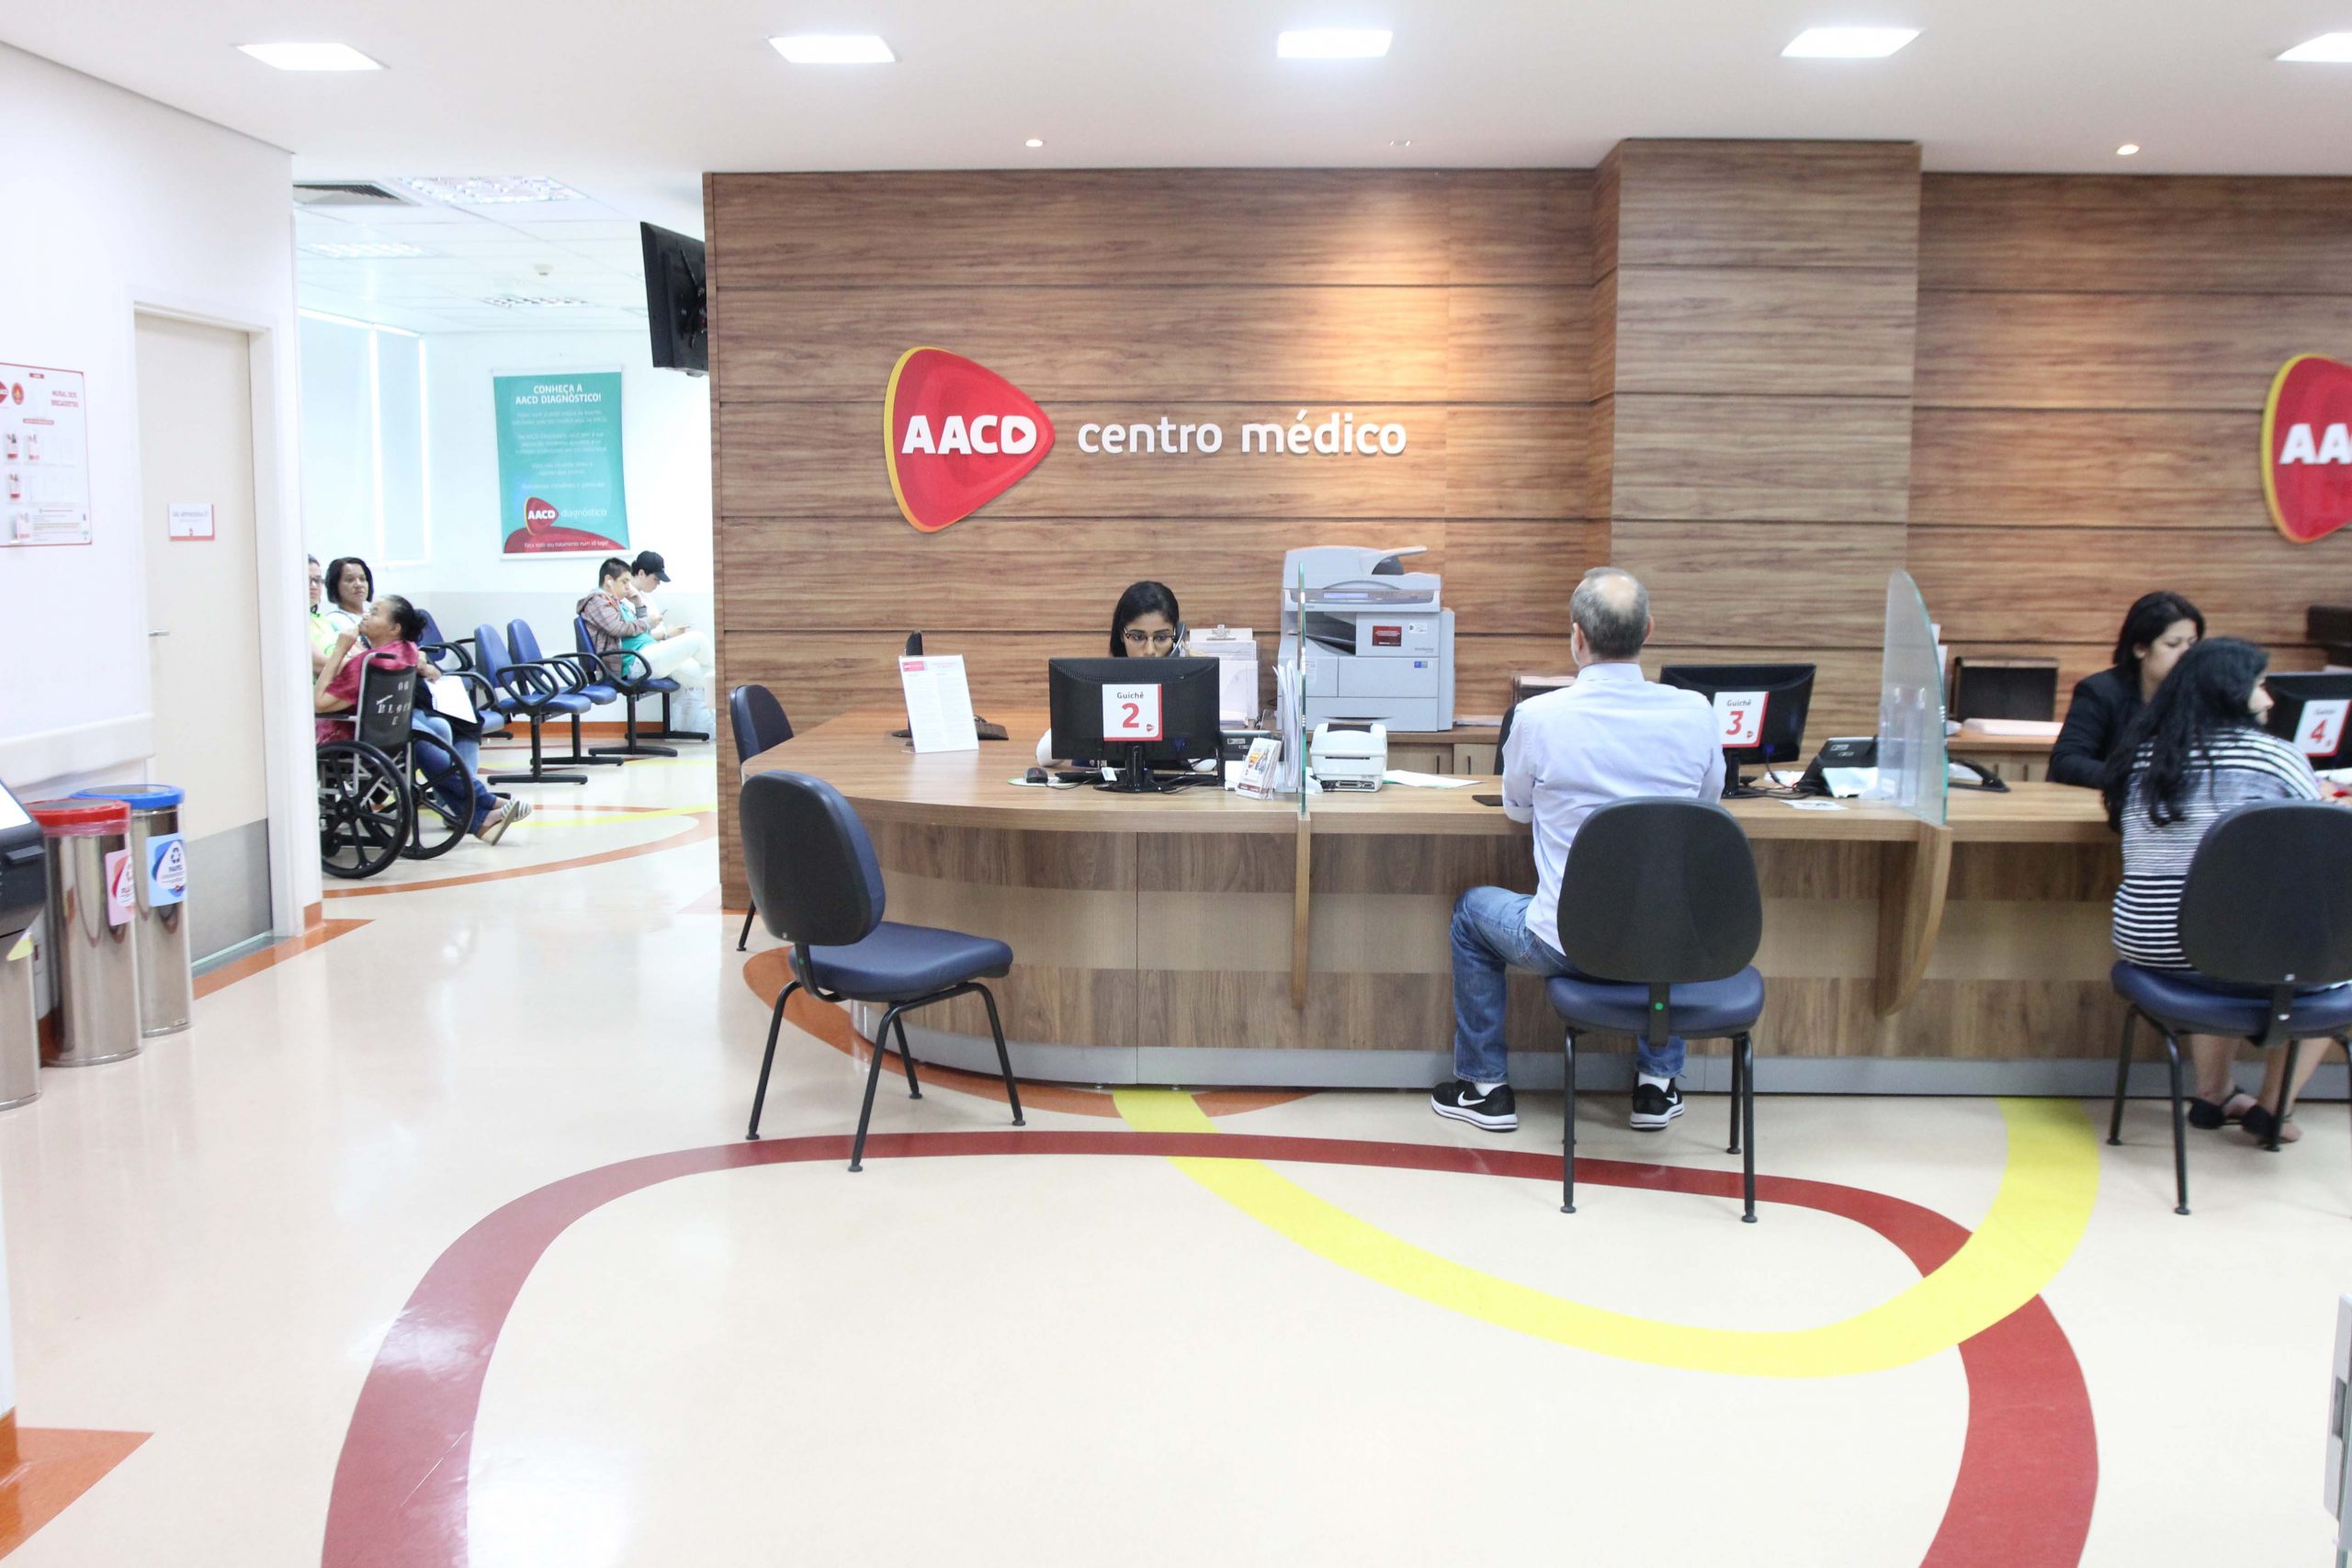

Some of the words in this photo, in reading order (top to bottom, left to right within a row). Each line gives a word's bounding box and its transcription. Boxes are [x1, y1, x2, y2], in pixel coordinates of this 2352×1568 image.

[515, 396, 538, 405] AACD
[540, 392, 602, 404] DIAGNÓSTICO!
[533, 383, 574, 395] CONHEÇA
[577, 383, 582, 392] A
[901, 414, 1037, 455] AACD
[1078, 416, 1223, 455] centro
[1241, 409, 1408, 455] médico
[2278, 423, 2352, 465] AA
[527, 510, 556, 520] AACD
[560, 507, 607, 520] diagnóstico
[1122, 703, 1139, 728] 2
[1725, 710, 1744, 735] 3
[2311, 719, 2326, 743] 4
